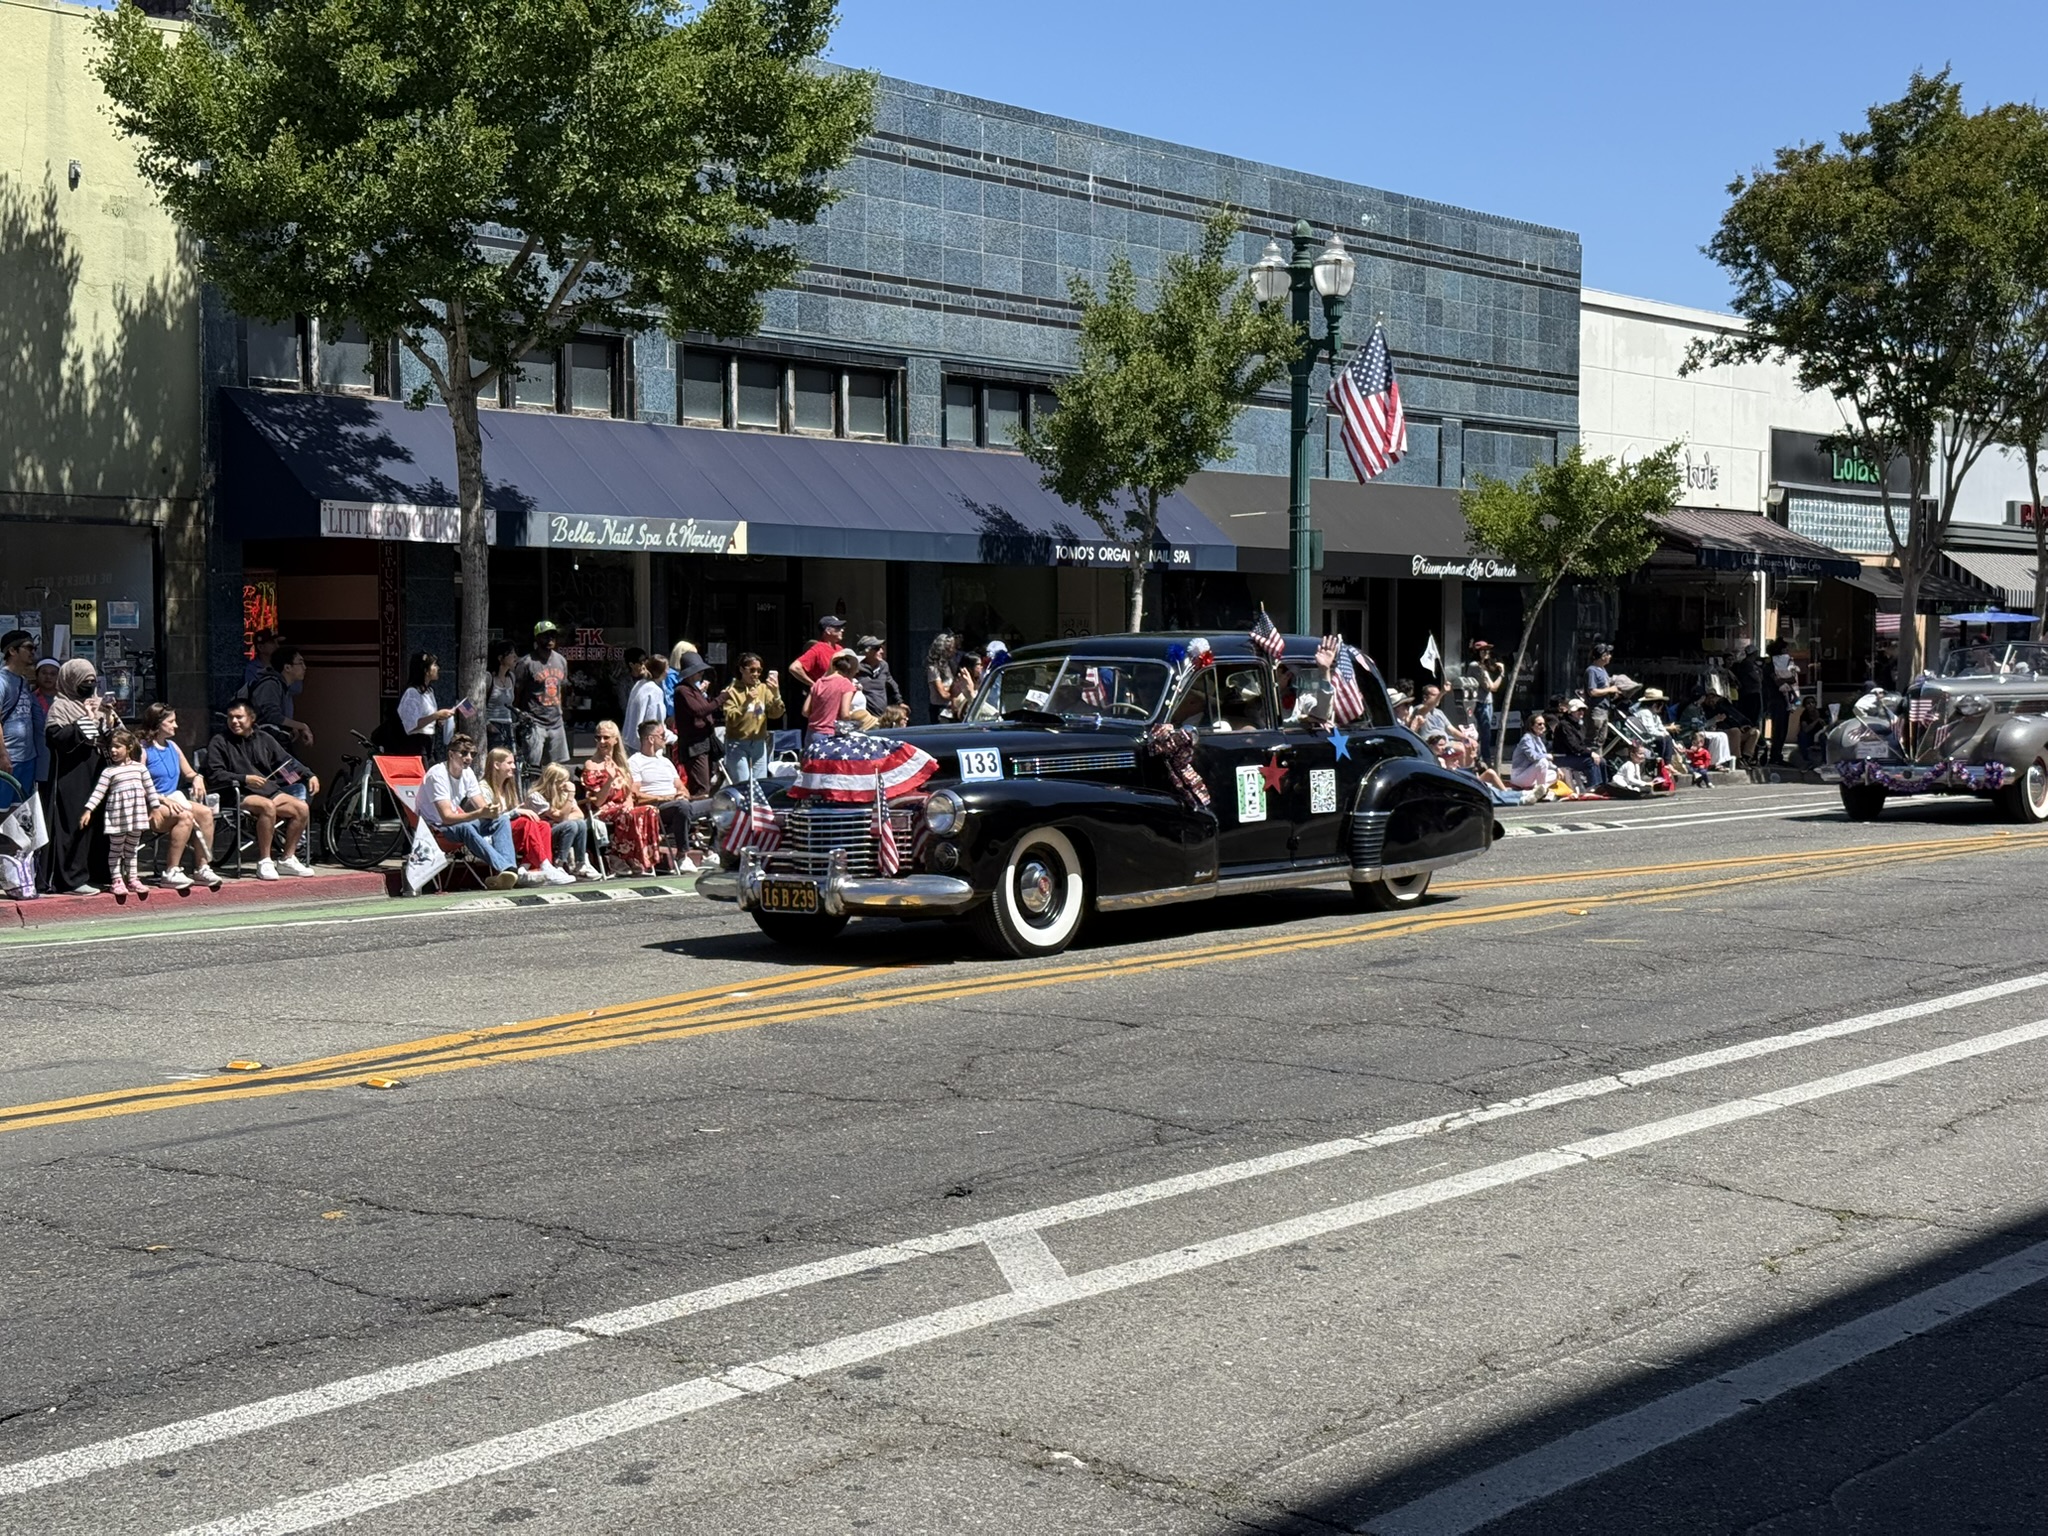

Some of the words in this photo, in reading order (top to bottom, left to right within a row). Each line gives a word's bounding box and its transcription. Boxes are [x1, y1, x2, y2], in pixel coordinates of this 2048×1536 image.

[328, 507, 382, 536] LITTLE
[551, 516, 596, 543] Bella
[597, 518, 634, 546] Nail
[636, 523, 662, 549] Spa
[665, 522, 679, 547] &
[679, 523, 727, 552] Waxing
[1098, 546, 1143, 563] ORGA
[1149, 550, 1170, 563] NAIL
[1173, 550, 1191, 563] SPA
[1412, 554, 1465, 579] Triumphant
[1466, 558, 1484, 580] Life
[1485, 559, 1517, 578] Church
[74, 603, 92, 611] IMP
[575, 628, 604, 646] TK
[385, 625, 395, 688] TELLER
[587, 646, 606, 660] SHOP
[965, 753, 998, 774] 133
[792, 889, 815, 908] 239
